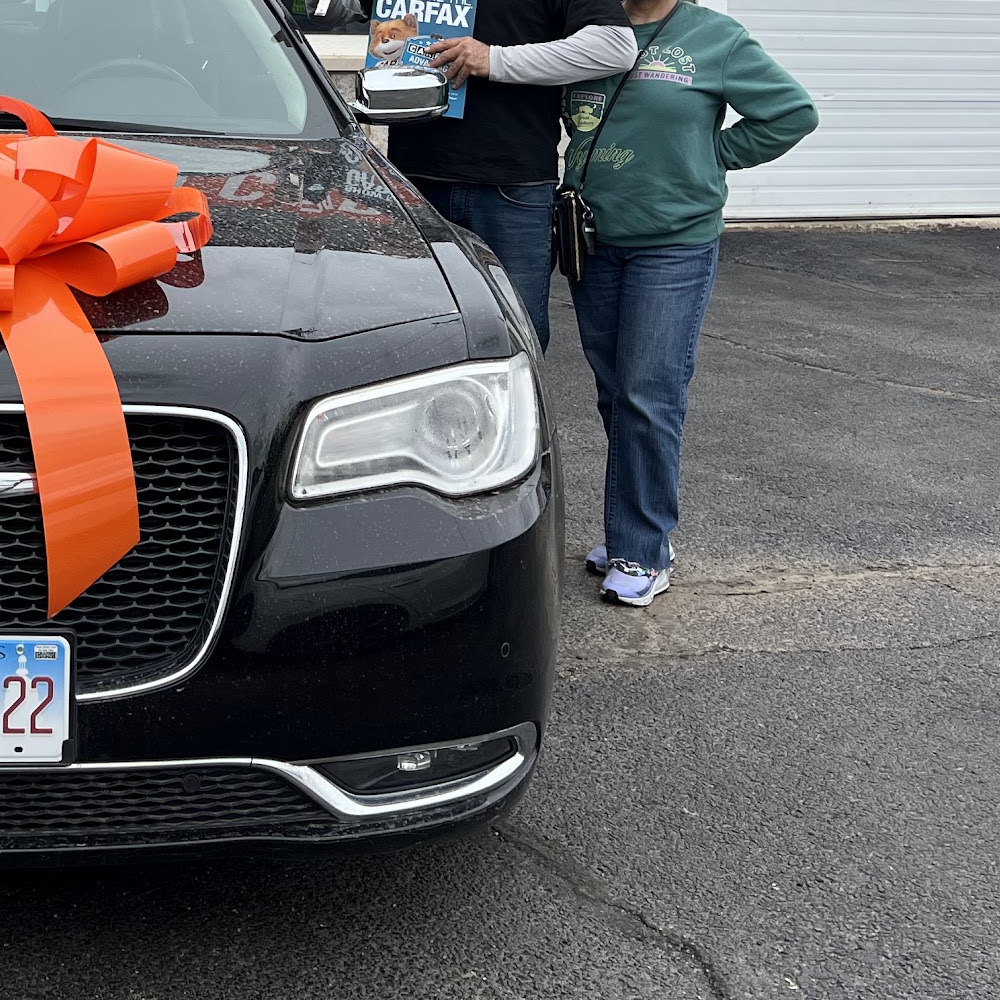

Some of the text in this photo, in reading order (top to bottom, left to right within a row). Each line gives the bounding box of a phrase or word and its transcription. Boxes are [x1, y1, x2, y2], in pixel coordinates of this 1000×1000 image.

[638, 45, 696, 74] OT LOST
[630, 71, 689, 84] UST WANDERING
[573, 93, 603, 102] EXPLORE
